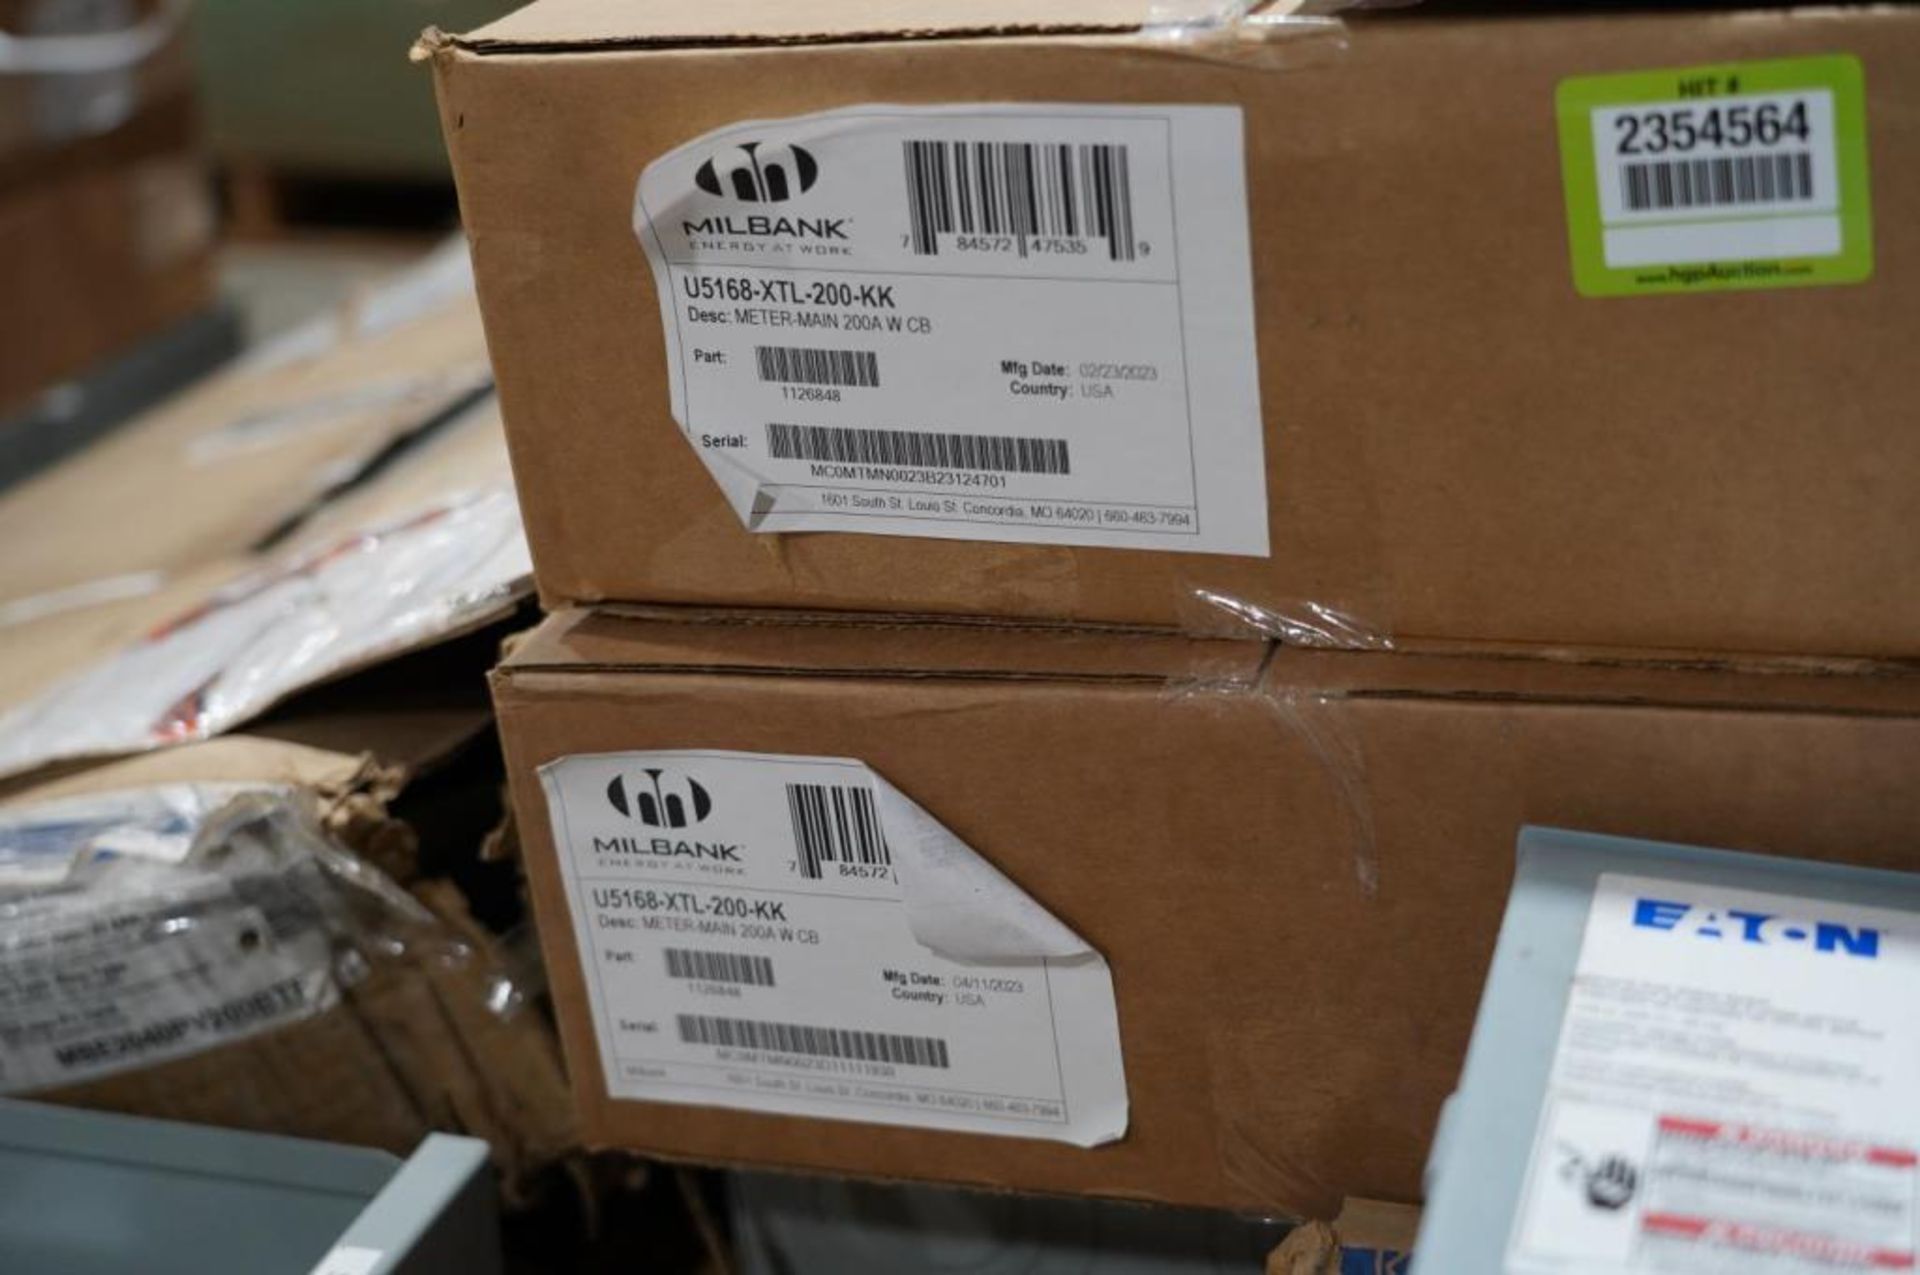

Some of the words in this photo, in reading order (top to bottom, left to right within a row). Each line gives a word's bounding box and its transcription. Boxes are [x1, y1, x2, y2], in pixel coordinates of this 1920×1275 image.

[1614, 100, 1810, 155] 2354564
[682, 215, 849, 240] MILBANK
[689, 240, 766, 252] ENERGY
[772, 242, 793, 252] AT
[799, 244, 852, 256] WORK
[902, 234, 910, 248] 7
[956, 236, 1012, 252] 84572
[1030, 238, 1088, 255] 47535
[1138, 241, 1151, 257] 9
[684, 275, 896, 309] U5168-XTL-200-KK
[688, 306, 731, 324] Desc:
[735, 309, 839, 329] METER-MAIN
[844, 316, 882, 332] 200A
[886, 317, 902, 332] W
[907, 317, 932, 334] CB
[694, 348, 727, 364] Part:
[1001, 360, 1028, 379] Mfg
[1032, 361, 1070, 378] Date:
[1079, 363, 1158, 381] 02/23/2023
[782, 386, 841, 403] 1126848
[1010, 380, 1073, 400] Country:
[1081, 384, 1114, 398] USA
[702, 434, 748, 449] Serial:
[822, 493, 848, 506] 1601
[853, 494, 886, 508] South
[908, 497, 940, 512] Louis
[1031, 505, 1053, 518] MO
[1057, 507, 1095, 521] 64020
[593, 837, 742, 862] MILBANK
[787, 860, 796, 873] 7
[839, 863, 889, 880] 84572
[593, 887, 787, 922] U5168-XTL-200-KK
[642, 915, 737, 936] METER-MAIN
[740, 923, 775, 940] 200A
[779, 928, 794, 942] W
[797, 928, 820, 945] CB
[1633, 898, 1880, 958] EATON
[883, 969, 907, 986] Mfg
[910, 971, 945, 987] Date:
[955, 992, 985, 1006] USA
